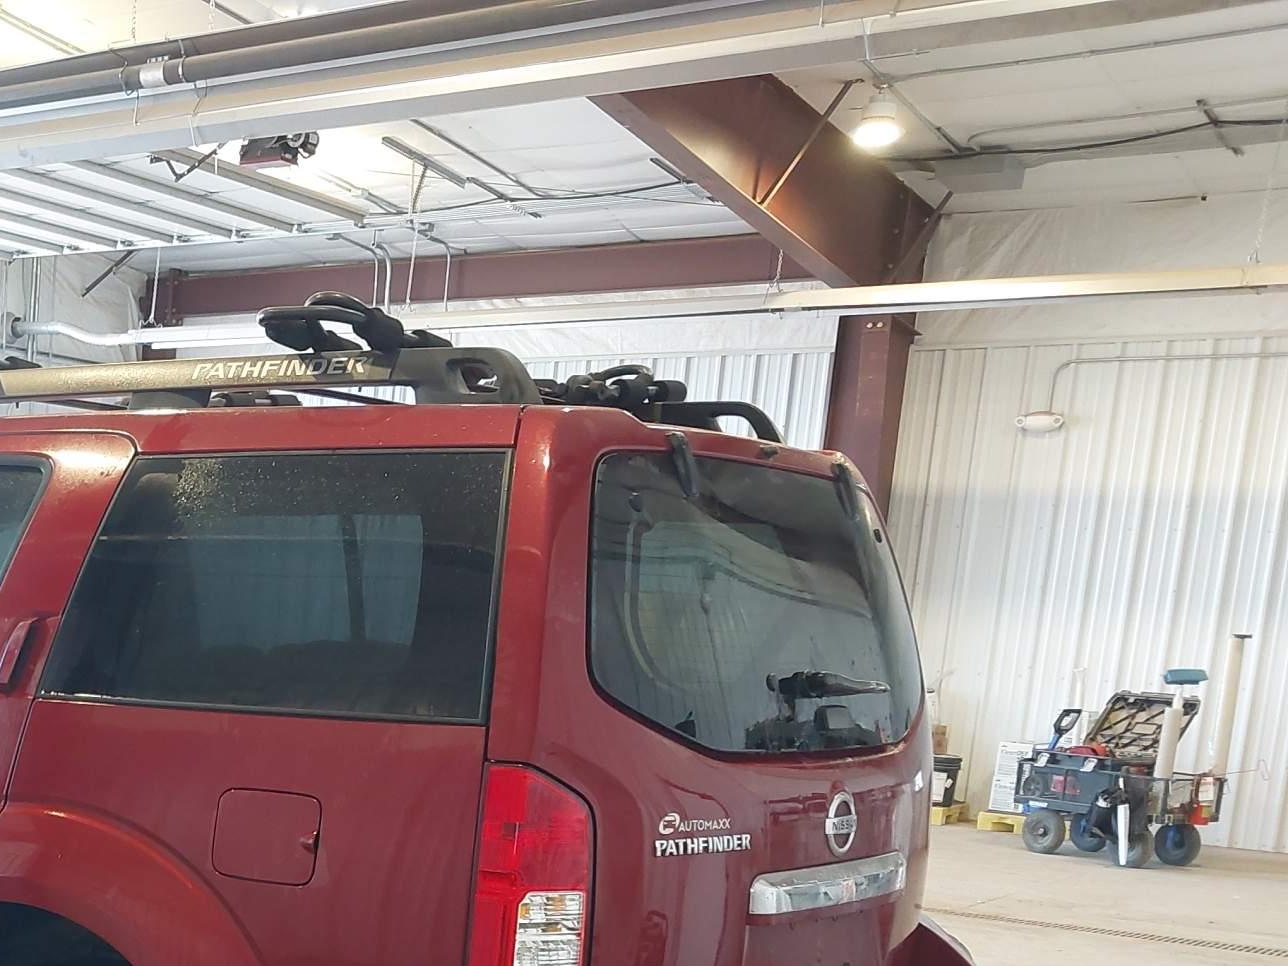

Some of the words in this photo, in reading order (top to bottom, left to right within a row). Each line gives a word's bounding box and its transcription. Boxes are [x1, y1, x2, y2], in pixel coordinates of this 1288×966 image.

[191, 356, 367, 380] PATHFINDER
[678, 818, 731, 832] AUTOMAXX
[655, 834, 751, 857] PATHFINDER
